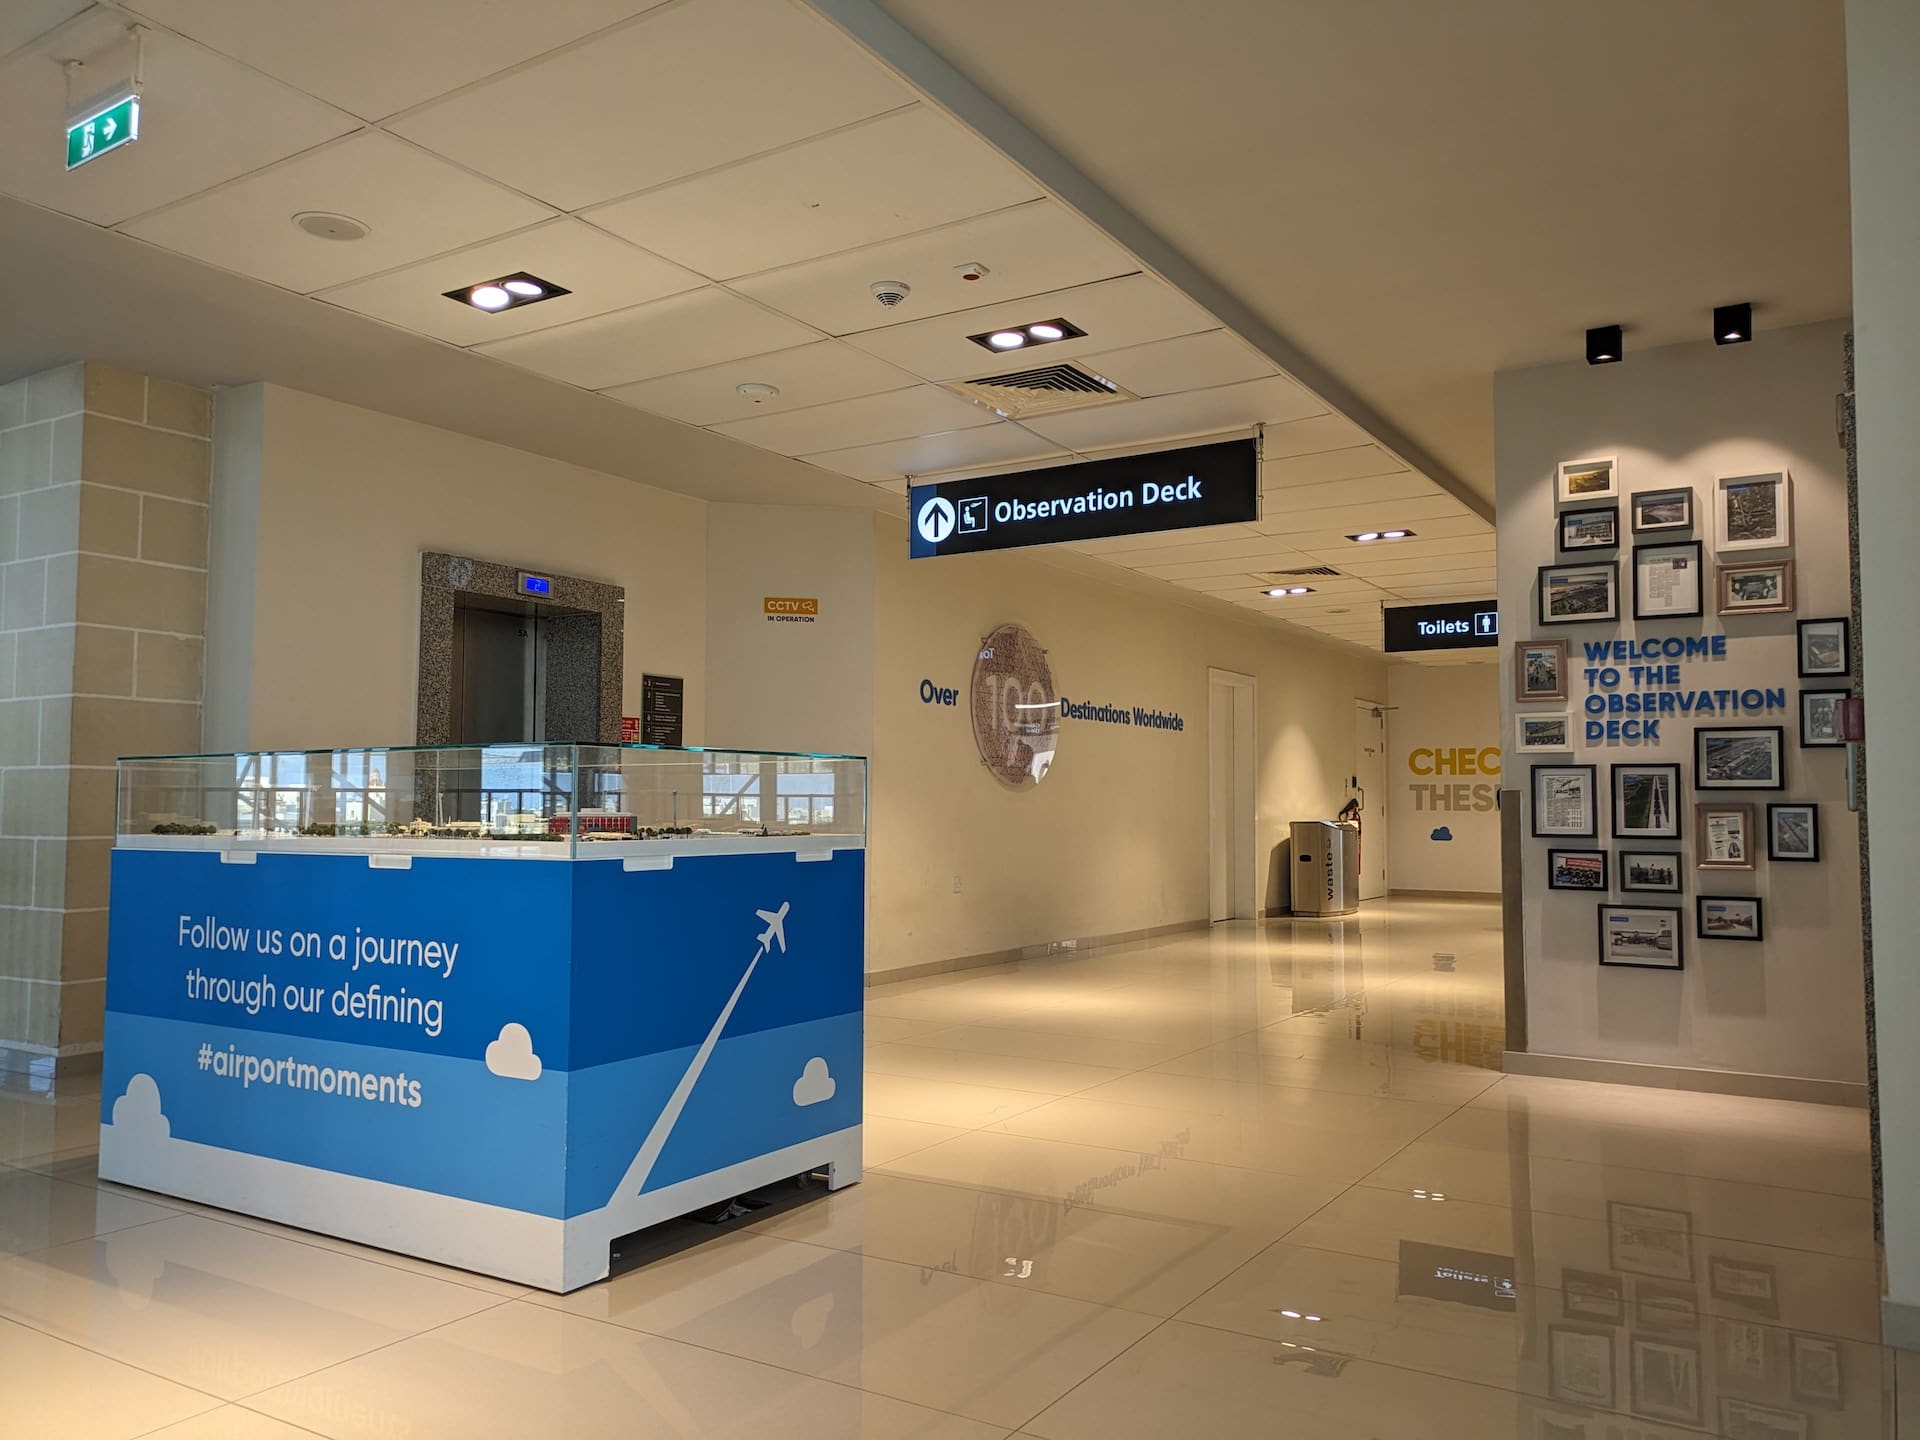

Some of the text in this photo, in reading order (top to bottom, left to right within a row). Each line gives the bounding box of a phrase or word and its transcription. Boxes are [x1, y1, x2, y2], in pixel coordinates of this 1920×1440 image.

[994, 475, 1202, 523] Observation Deck
[767, 600, 800, 611] CCTV
[775, 615, 815, 623] OPERATION
[1417, 619, 1470, 635] Toilets
[1583, 635, 1727, 662] WELCOME
[1584, 664, 1680, 688] TO THE
[920, 679, 960, 706] Over
[986, 674, 1047, 732] 100
[1060, 696, 1131, 726] Destinations
[1133, 706, 1184, 732] Worldwide
[1584, 687, 1785, 715] OBSERVATION
[1585, 719, 1660, 740] DECK
[1325, 851, 1334, 901] waste
[178, 915, 459, 979] Follow us on a journey
[186, 968, 443, 1037] through our defining
[197, 1043, 423, 1108] #airportmoments
